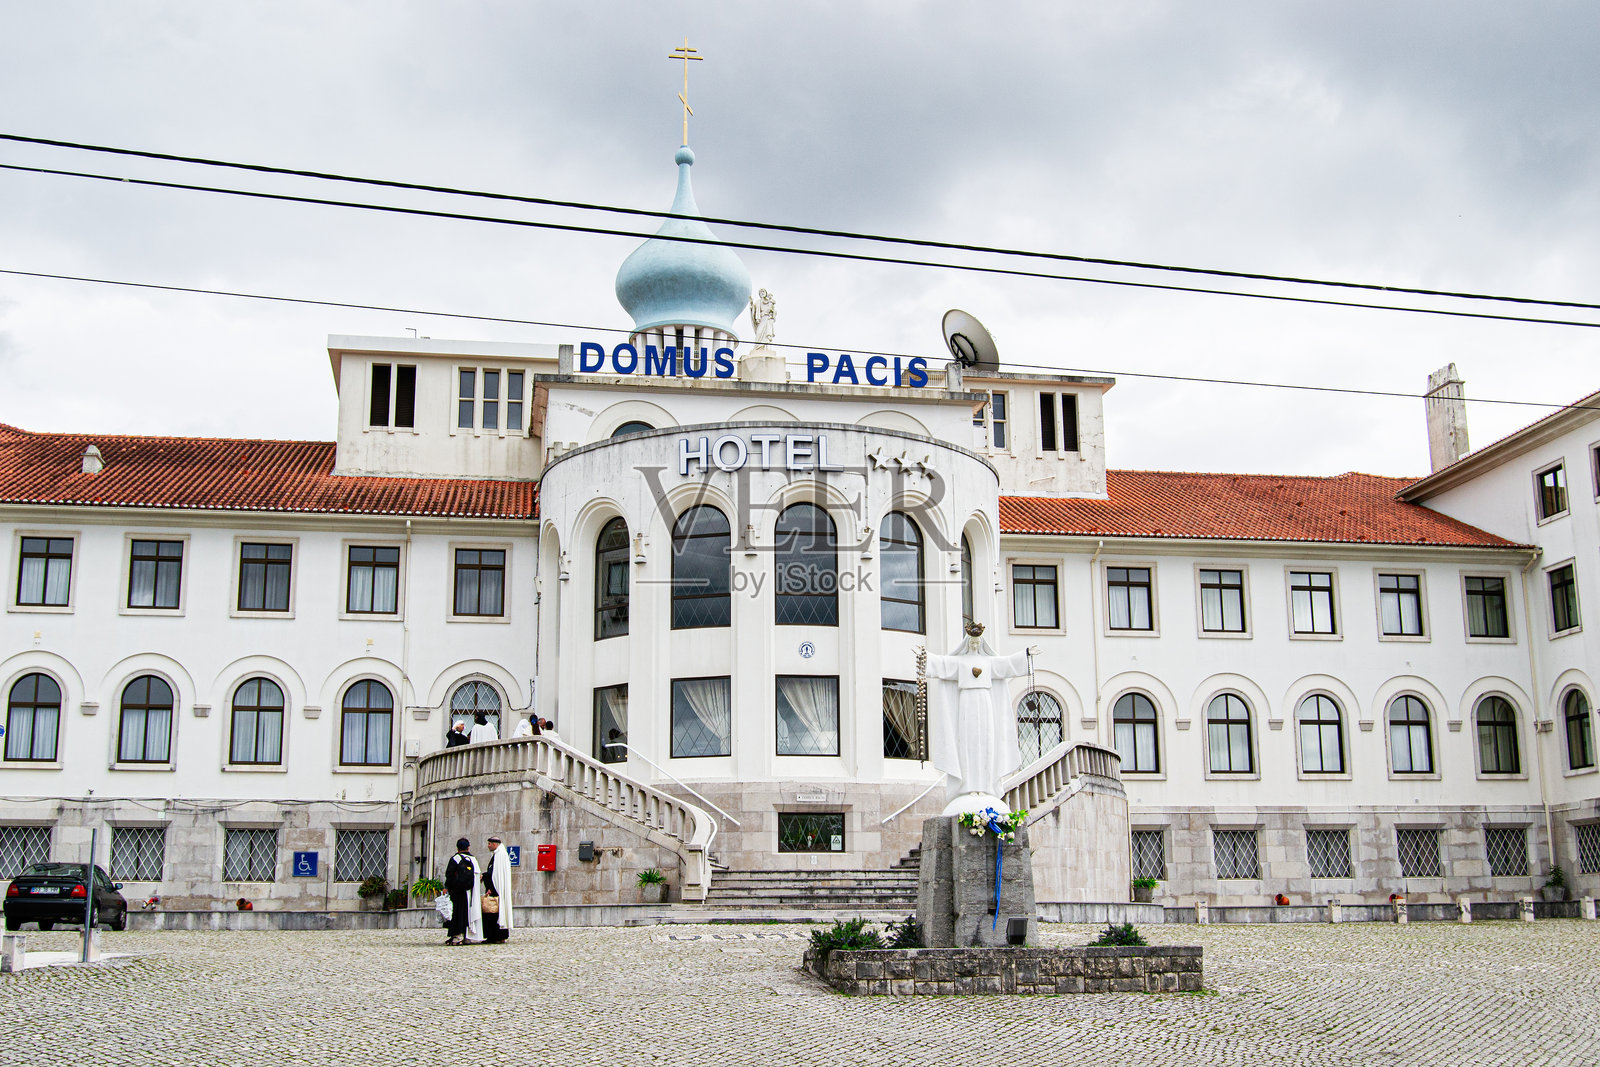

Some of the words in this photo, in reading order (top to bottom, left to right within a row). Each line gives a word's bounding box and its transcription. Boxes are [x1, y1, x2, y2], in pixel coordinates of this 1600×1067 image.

[580, 342, 735, 378] DOMUS
[806, 353, 929, 388] PACIS
[679, 434, 844, 475] HOTEL
